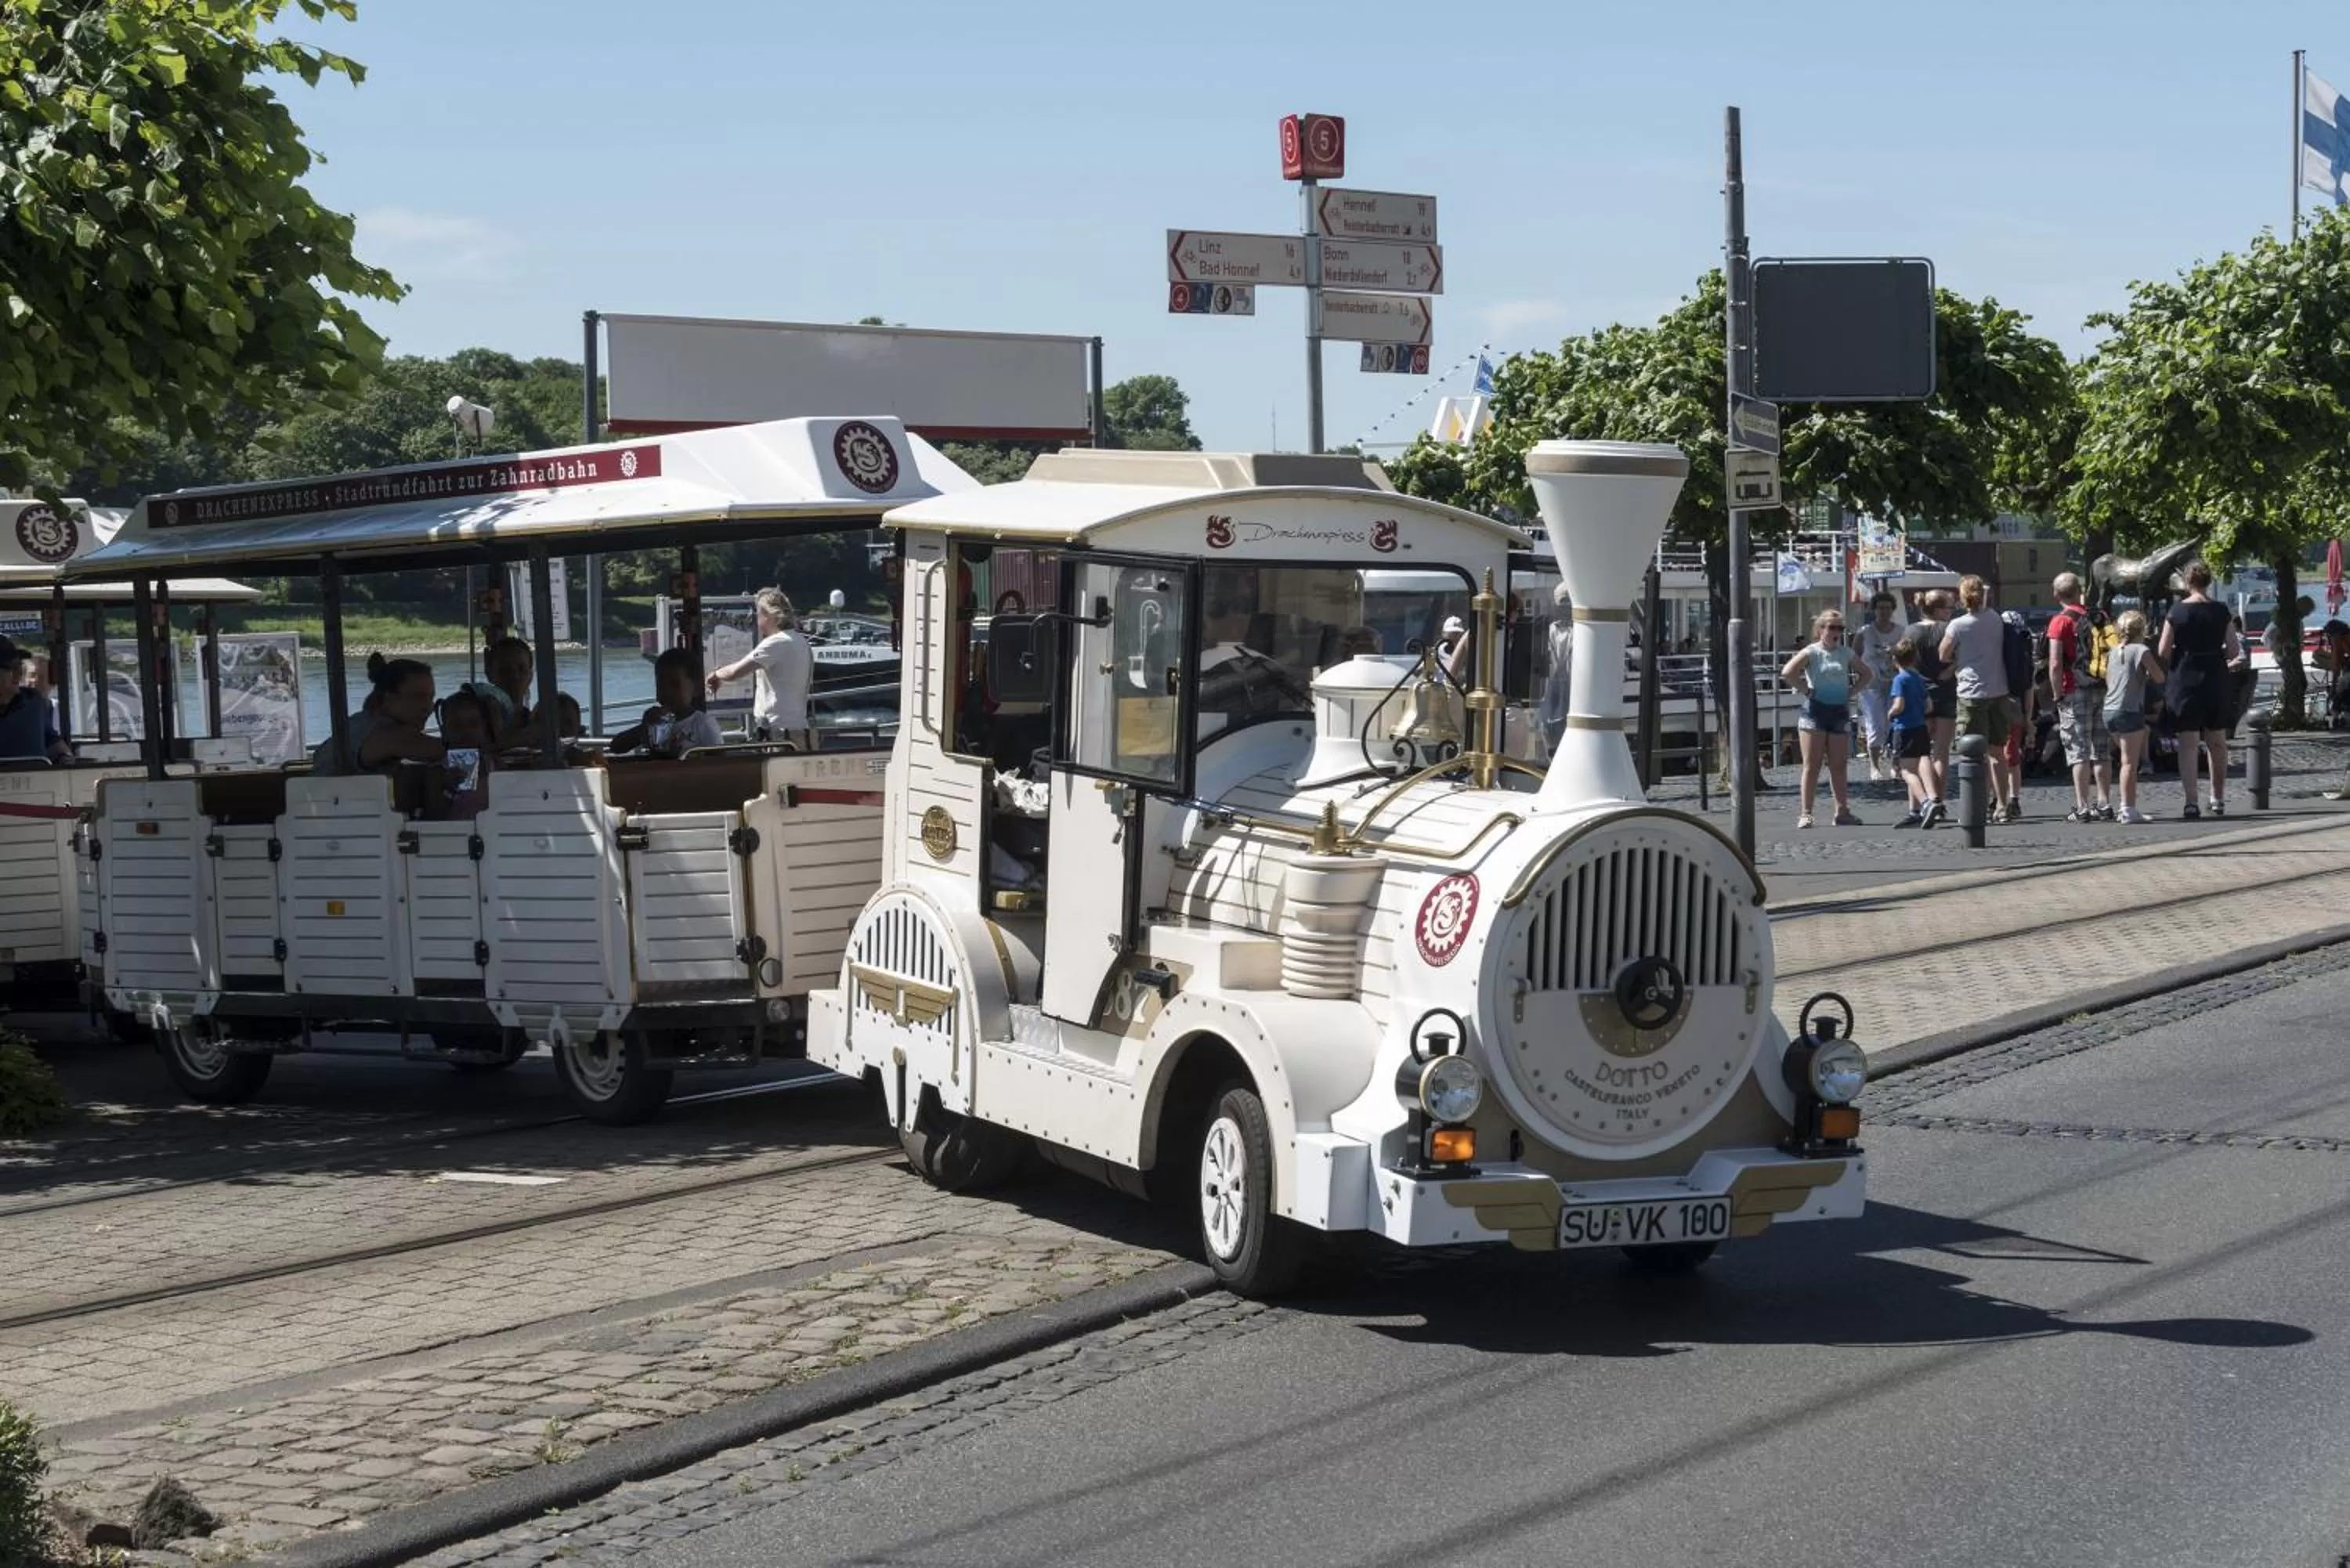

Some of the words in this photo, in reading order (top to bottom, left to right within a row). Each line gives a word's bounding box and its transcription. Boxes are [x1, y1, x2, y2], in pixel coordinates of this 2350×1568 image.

[1320, 129, 1329, 150] 5
[1198, 237, 1222, 255] Linz
[1324, 245, 1350, 262] Bonn
[1199, 260, 1220, 276] Bad
[1223, 261, 1260, 277] Honnef
[197, 490, 320, 518] DRACHENEXPRESS
[457, 475, 483, 490] zur
[490, 460, 598, 487] Zahnradbahn
[1564, 1068, 1653, 1105] CASTELFRANCO
[1655, 1064, 1701, 1100] VENETO
[1595, 1060, 1668, 1088] DOTTO
[1616, 1107, 1650, 1119] ITALY
[1679, 1202, 1727, 1237] 100
